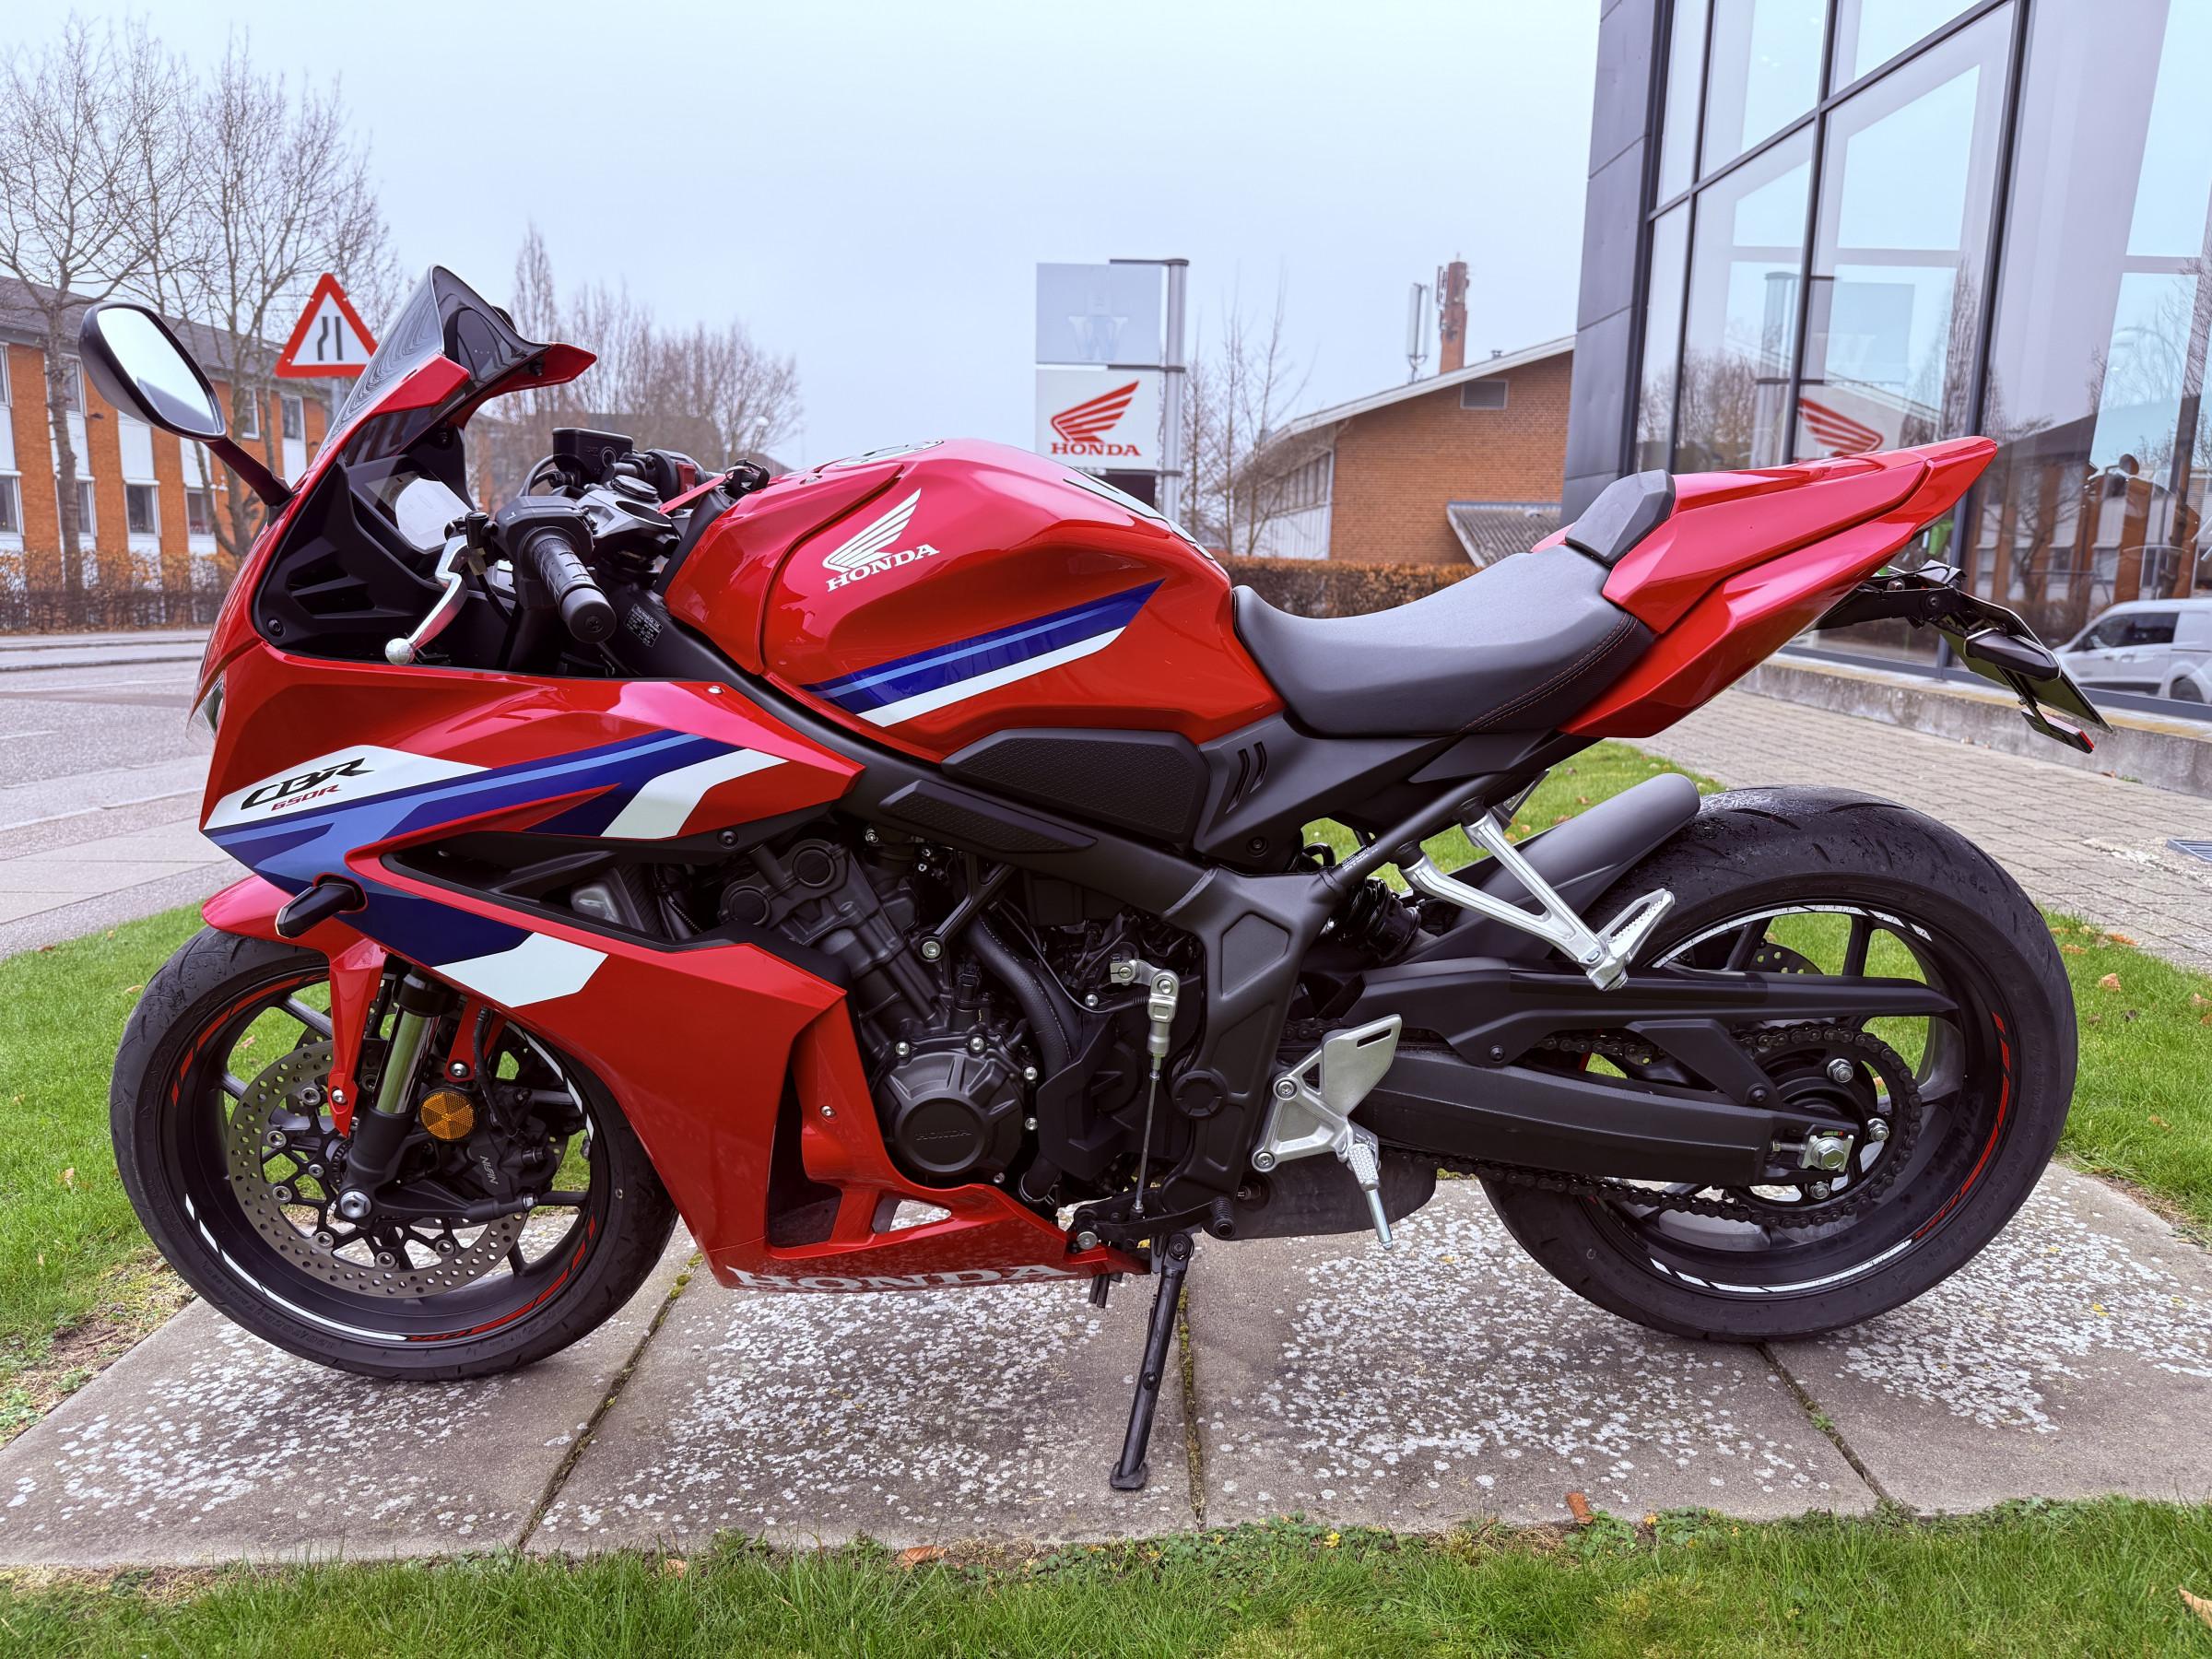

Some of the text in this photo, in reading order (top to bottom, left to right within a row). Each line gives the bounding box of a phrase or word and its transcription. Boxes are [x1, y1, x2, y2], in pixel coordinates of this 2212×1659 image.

[1051, 442, 1142, 456] HONDA
[826, 544, 940, 593] HONDA
[241, 758, 375, 810] CBR
[271, 784, 342, 811] 650R
[725, 1265, 1079, 1290] HONDA
